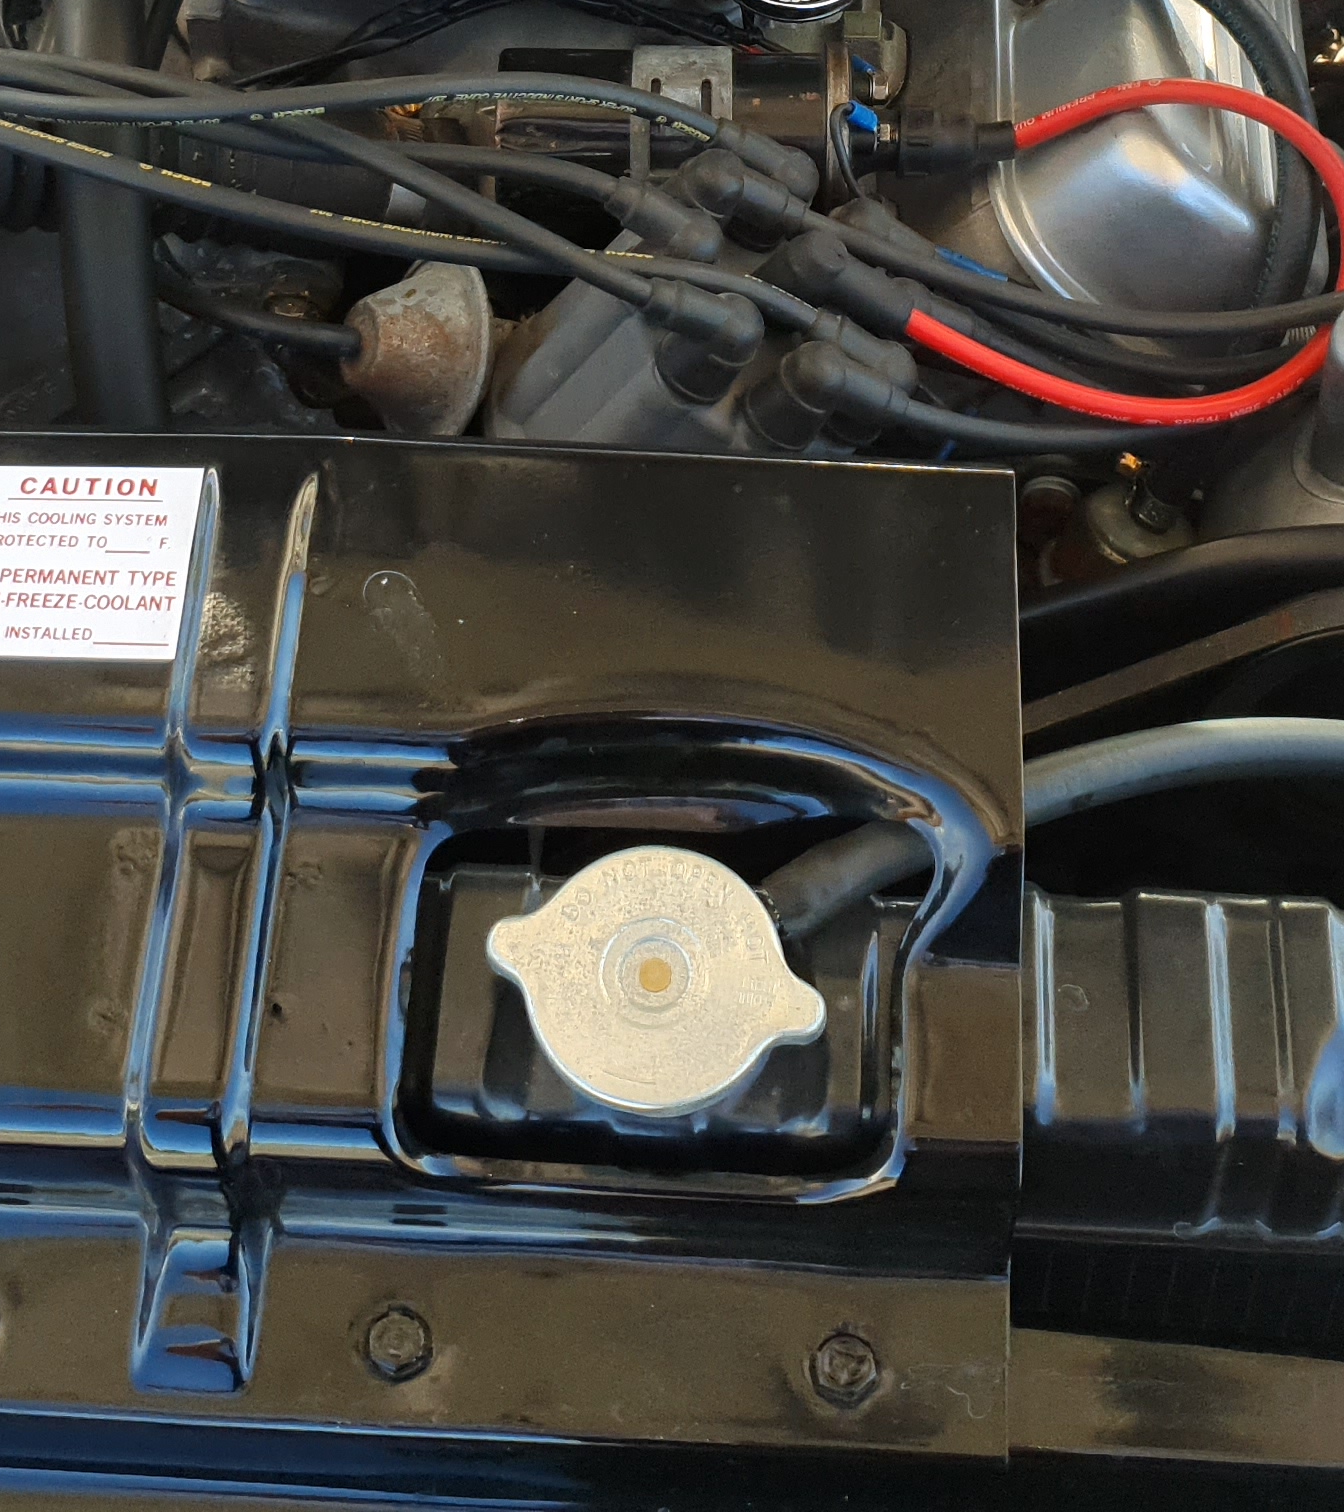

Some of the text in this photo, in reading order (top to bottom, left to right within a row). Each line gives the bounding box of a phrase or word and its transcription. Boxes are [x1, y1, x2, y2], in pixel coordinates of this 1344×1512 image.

[19, 477, 159, 496] CAUTION
[27, 512, 97, 526] COOLING
[103, 513, 168, 527] SYSTEM
[87, 536, 108, 549] TO
[0, 568, 120, 585] PERMANENT
[127, 570, 178, 587] TYPE
[4, 625, 93, 641] INSTALLED
[561, 887, 594, 922] DO
[602, 856, 653, 887] NOT
[667, 857, 737, 909] OPEN
